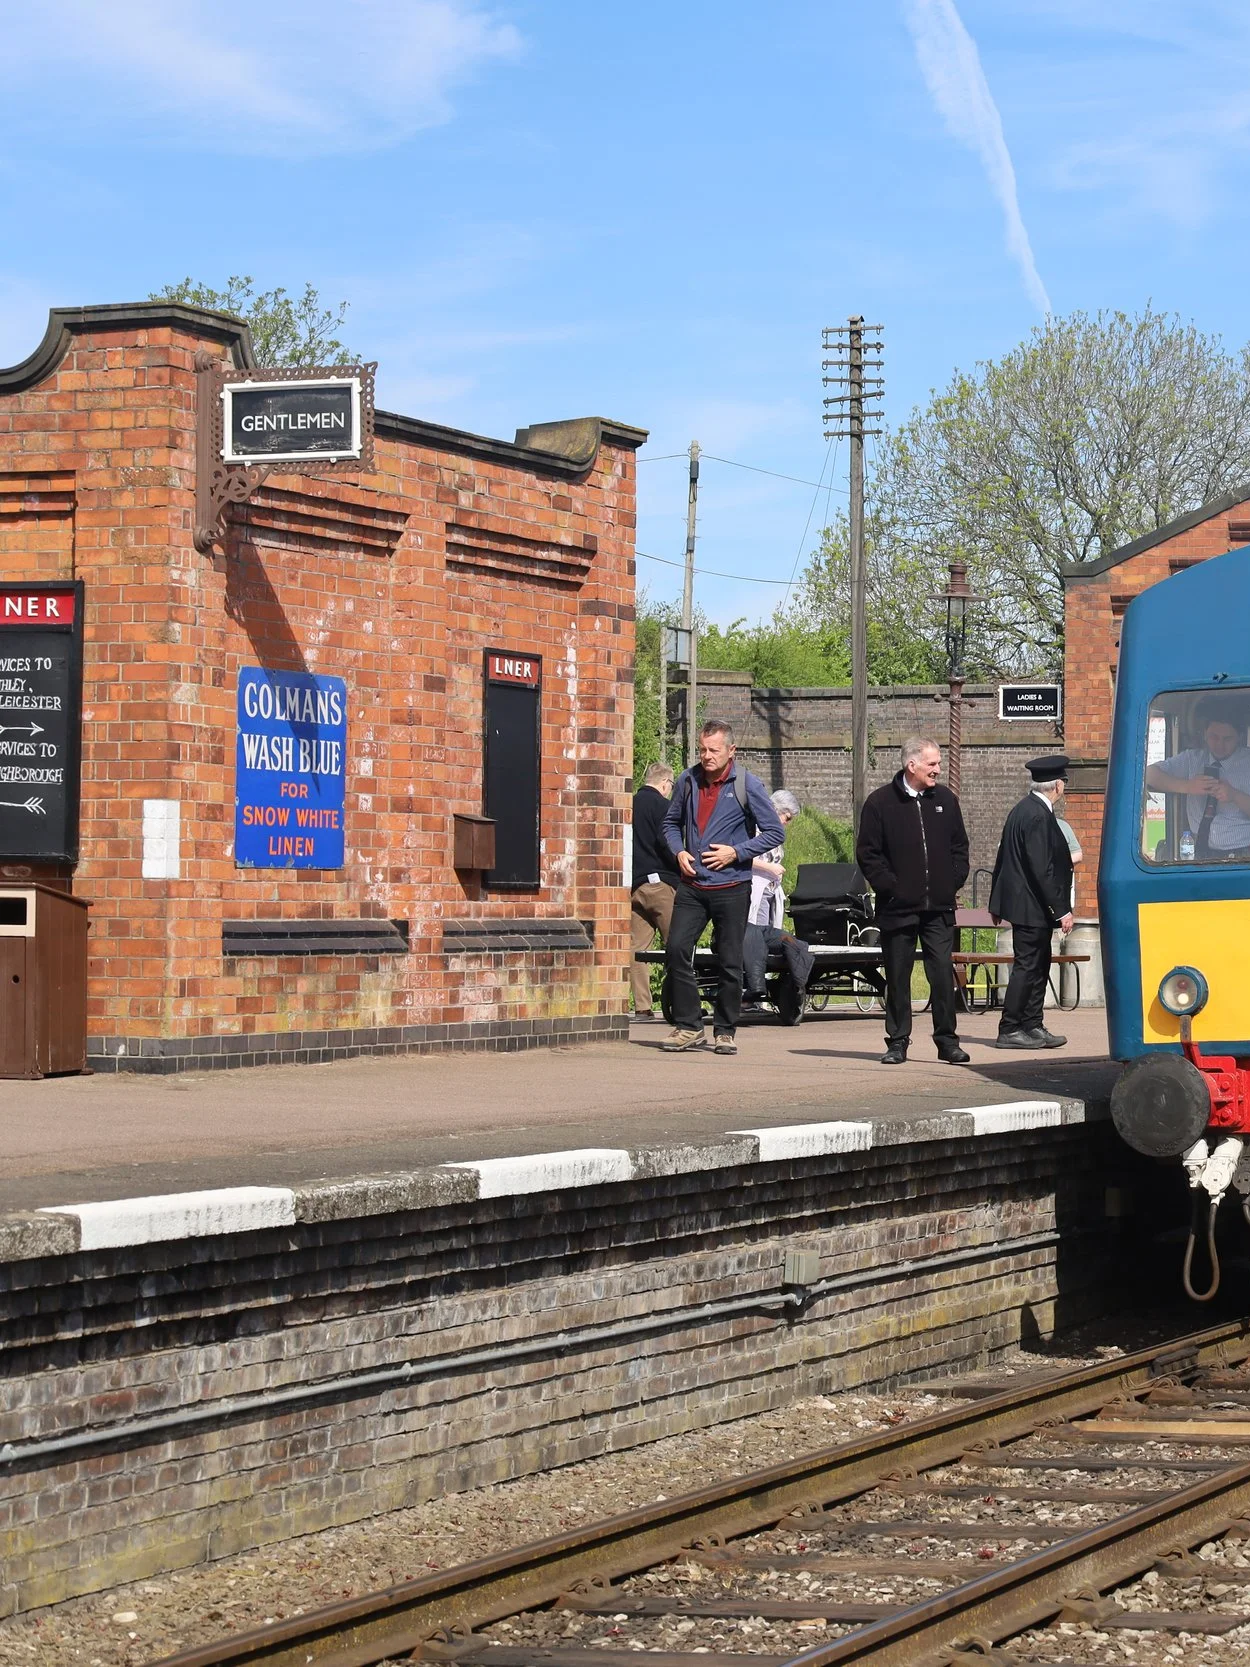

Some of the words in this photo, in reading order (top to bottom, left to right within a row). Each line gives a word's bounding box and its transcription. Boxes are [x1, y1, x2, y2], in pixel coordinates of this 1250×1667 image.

[241, 412, 345, 432] GENTLEMEN
[5, 597, 60, 617] NER
[0, 657, 31, 672] VICES
[34, 657, 52, 671] TO
[495, 657, 532, 678] LNER
[244, 682, 342, 726] COLMAN'S
[0, 741, 37, 756] RVICES
[39, 742, 57, 758] TO
[242, 733, 294, 772] WASH
[299, 738, 341, 776] BLUE
[0, 766, 64, 783] GHBOROUGH
[281, 782, 308, 798] FOR
[243, 805, 290, 827] SNOW
[296, 808, 339, 829] WHITE
[269, 836, 314, 856] LINEN
